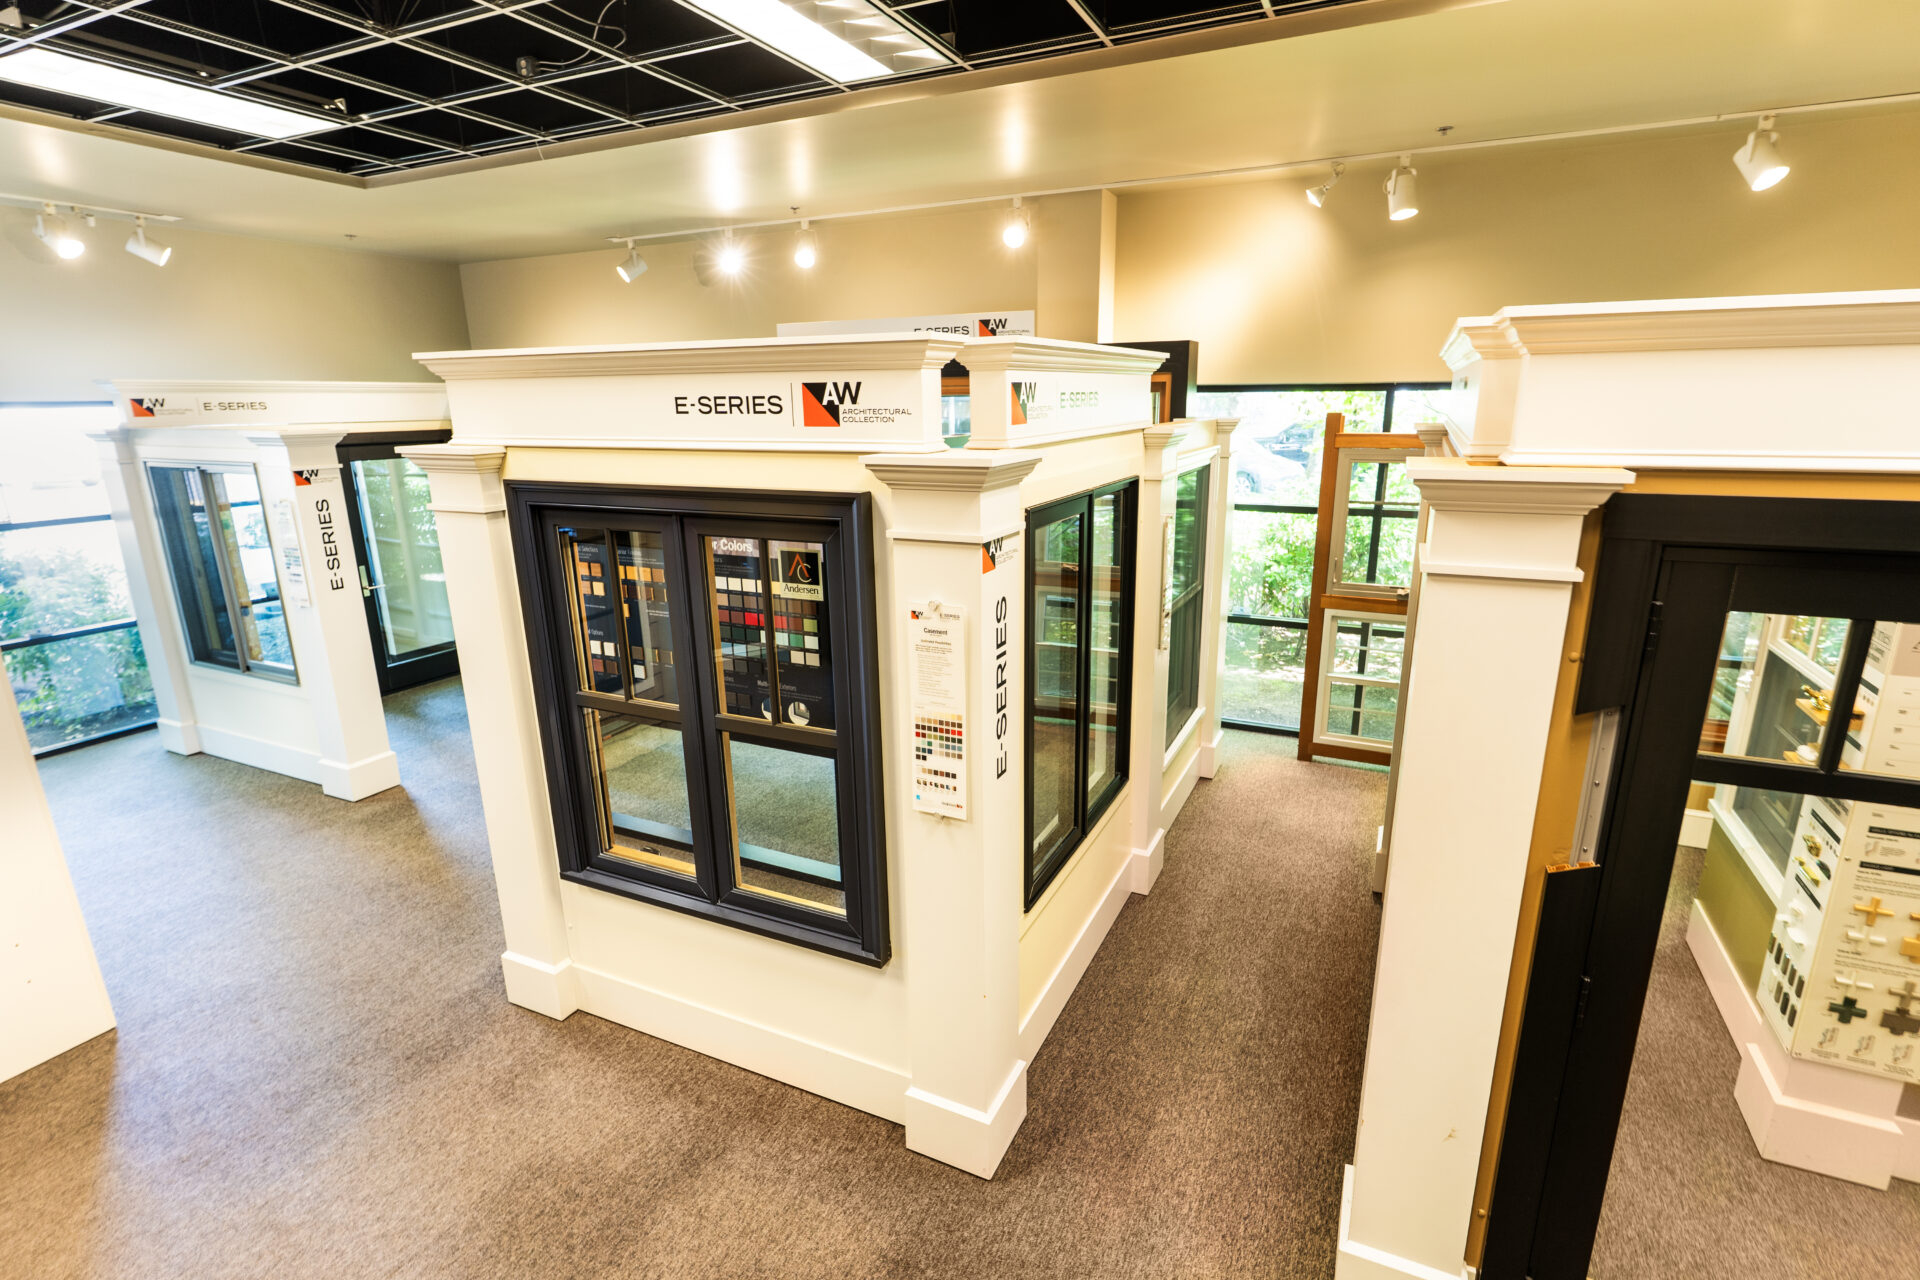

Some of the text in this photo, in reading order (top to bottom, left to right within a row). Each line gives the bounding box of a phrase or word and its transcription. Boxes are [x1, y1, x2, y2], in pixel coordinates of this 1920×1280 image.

[822, 381, 862, 406] AW
[1020, 381, 1037, 404] AW
[1060, 391, 1100, 409] E-SERIES
[203, 402, 268, 411] E-SERIES
[674, 395, 784, 415] E-SERIES
[842, 408, 913, 416] ARCHITECTURAL
[842, 416, 895, 424] COLLECTION
[302, 469, 319, 479] AW
[315, 499, 345, 591] E-SERIES
[720, 537, 753, 552] Colors
[989, 536, 1004, 556] AW
[783, 583, 820, 595] Andersen
[923, 627, 948, 635] Casement
[995, 595, 1008, 780] E-SERIES
